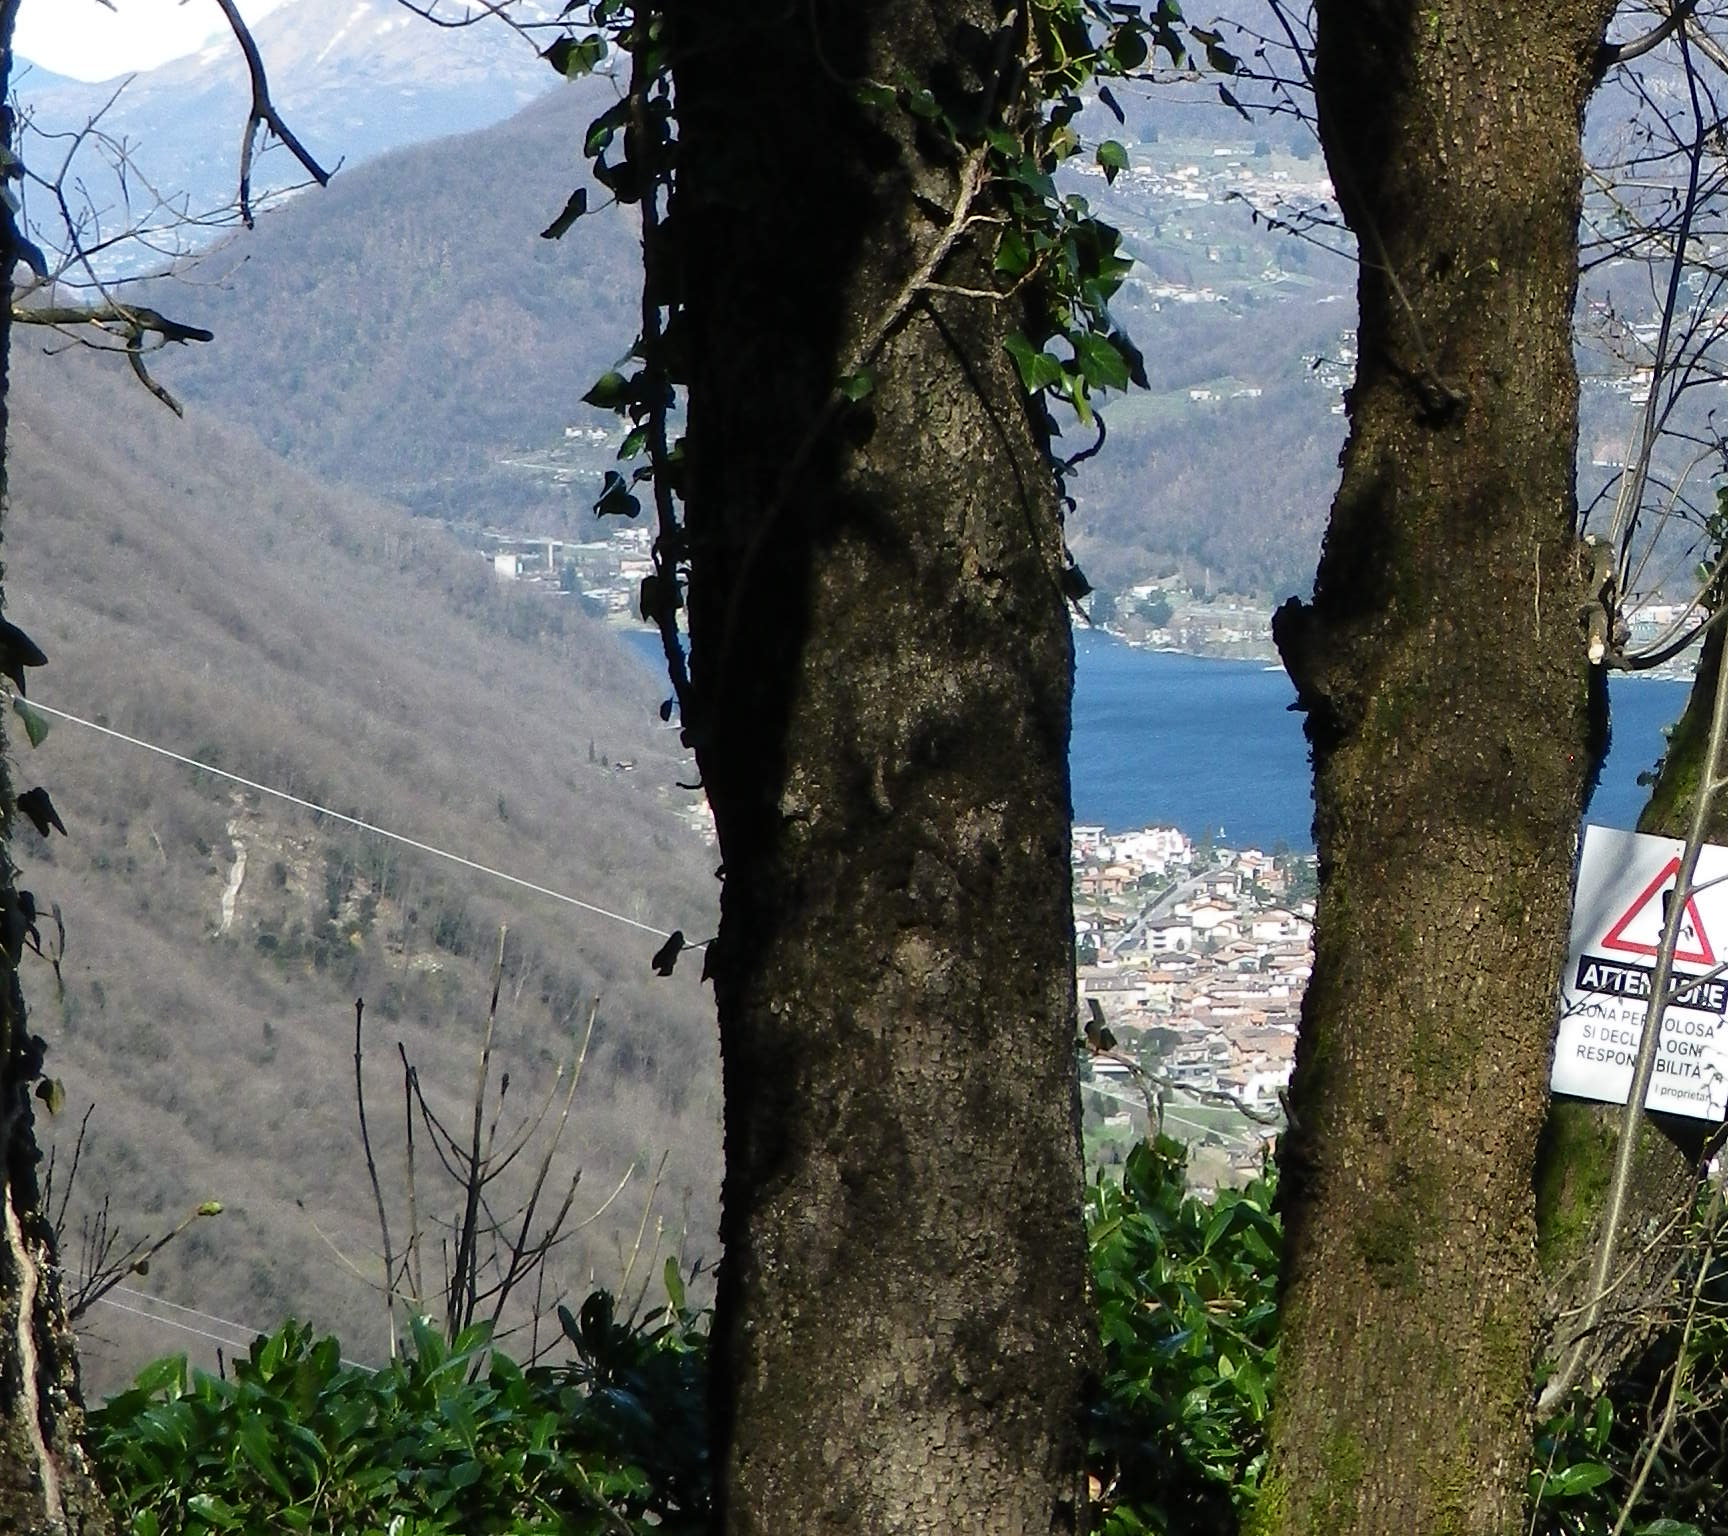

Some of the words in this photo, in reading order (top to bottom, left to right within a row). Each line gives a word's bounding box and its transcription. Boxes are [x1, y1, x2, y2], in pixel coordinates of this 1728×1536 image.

[1581, 963, 1725, 1010] ATTENIONE
[1583, 1024, 1596, 1039] SI
[1621, 1009, 1715, 1039] PEROLOSA
[1576, 1044, 1701, 1080] RESPONBILITÀ
[1660, 1086, 1712, 1103] proprietar
